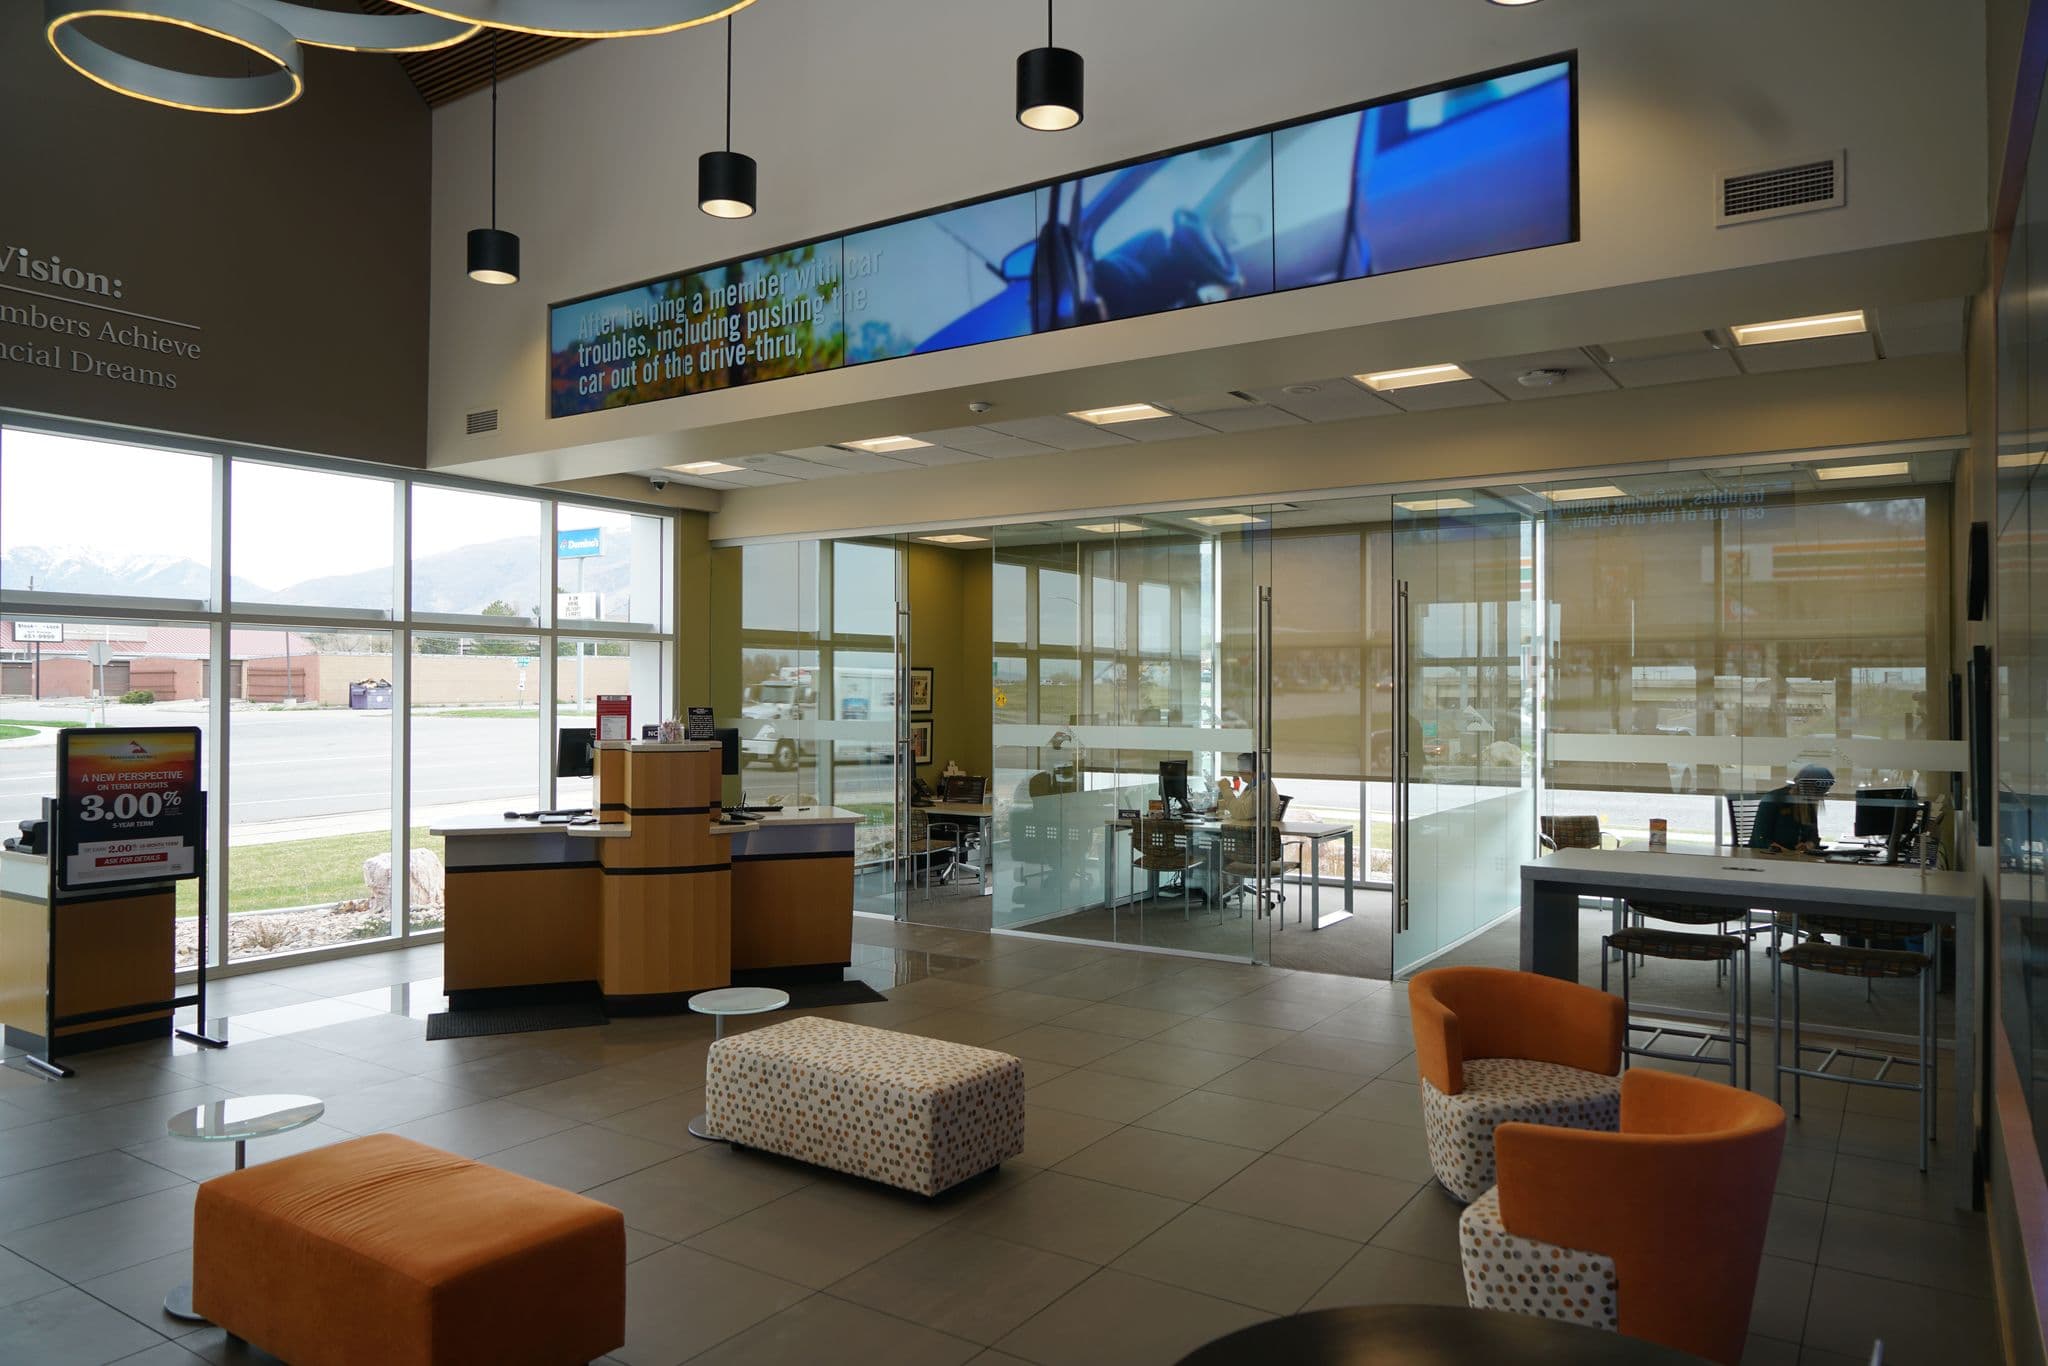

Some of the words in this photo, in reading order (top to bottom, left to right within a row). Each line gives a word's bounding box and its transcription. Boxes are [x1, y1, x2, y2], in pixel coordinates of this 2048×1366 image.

[578, 311, 615, 340] After
[623, 295, 687, 331] helping
[691, 292, 704, 314] a
[709, 271, 788, 311] member
[796, 257, 838, 290] with
[847, 249, 884, 282] car
[0, 304, 91, 338] mbers
[96, 321, 202, 360] Achieve
[578, 332, 651, 369] troubles,
[657, 312, 740, 351] including
[747, 293, 826, 340] pushing
[830, 284, 868, 316] the
[70, 350, 178, 390] Dreams
[578, 371, 606, 396] car
[610, 360, 638, 390] out
[642, 355, 661, 384] of
[664, 350, 694, 380] the
[699, 333, 803, 373] drive-thru,
[81, 774, 89, 783] A
[91, 773, 116, 782] NEW
[118, 770, 184, 781] PERSPECTIVE
[111, 783, 132, 791] TERM
[133, 781, 169, 790] DEPOSITS
[80, 790, 182, 821] 3.00%
[134, 854, 161, 863] DETAILS
